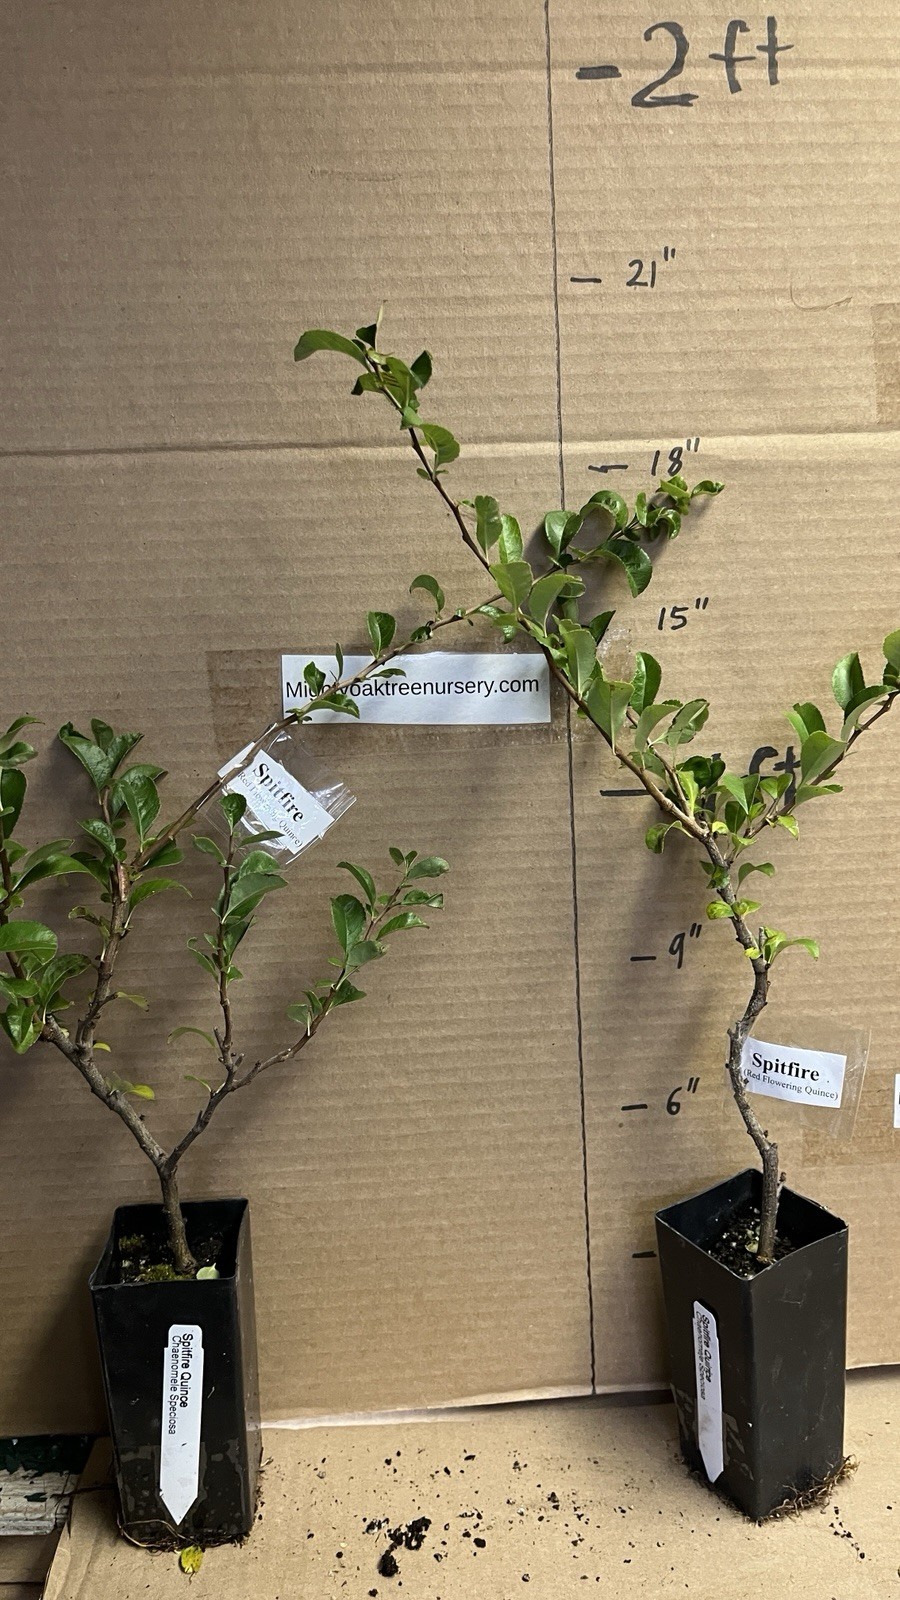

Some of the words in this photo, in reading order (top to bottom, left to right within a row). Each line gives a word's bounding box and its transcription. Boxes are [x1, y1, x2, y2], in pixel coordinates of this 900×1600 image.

[708, 15, 794, 94] ft
[626, 246, 677, 288] 21"
[651, 437, 700, 476] 18"
[657, 597, 709, 630] 15"
[286, 678, 539, 700] Mioaktreenursery.com
[238, 771, 252, 788] Red
[252, 763, 304, 823] Spitfire
[668, 923, 702, 969] 9"
[743, 1068, 761, 1081] (Red
[762, 1074, 803, 1094] Flowering
[804, 1085, 839, 1101] Quince)
[752, 1052, 820, 1081] Spitfire
[666, 1077, 700, 1115] 6"
[702, 1314, 711, 1348] Spitfire
[170, 1335, 181, 1392] Chaenomele
[181, 1333, 194, 1369] Spitfire
[704, 1349, 713, 1383] Quince
[179, 1371, 192, 1408] Quince
[168, 1393, 179, 1435] Speciosa
